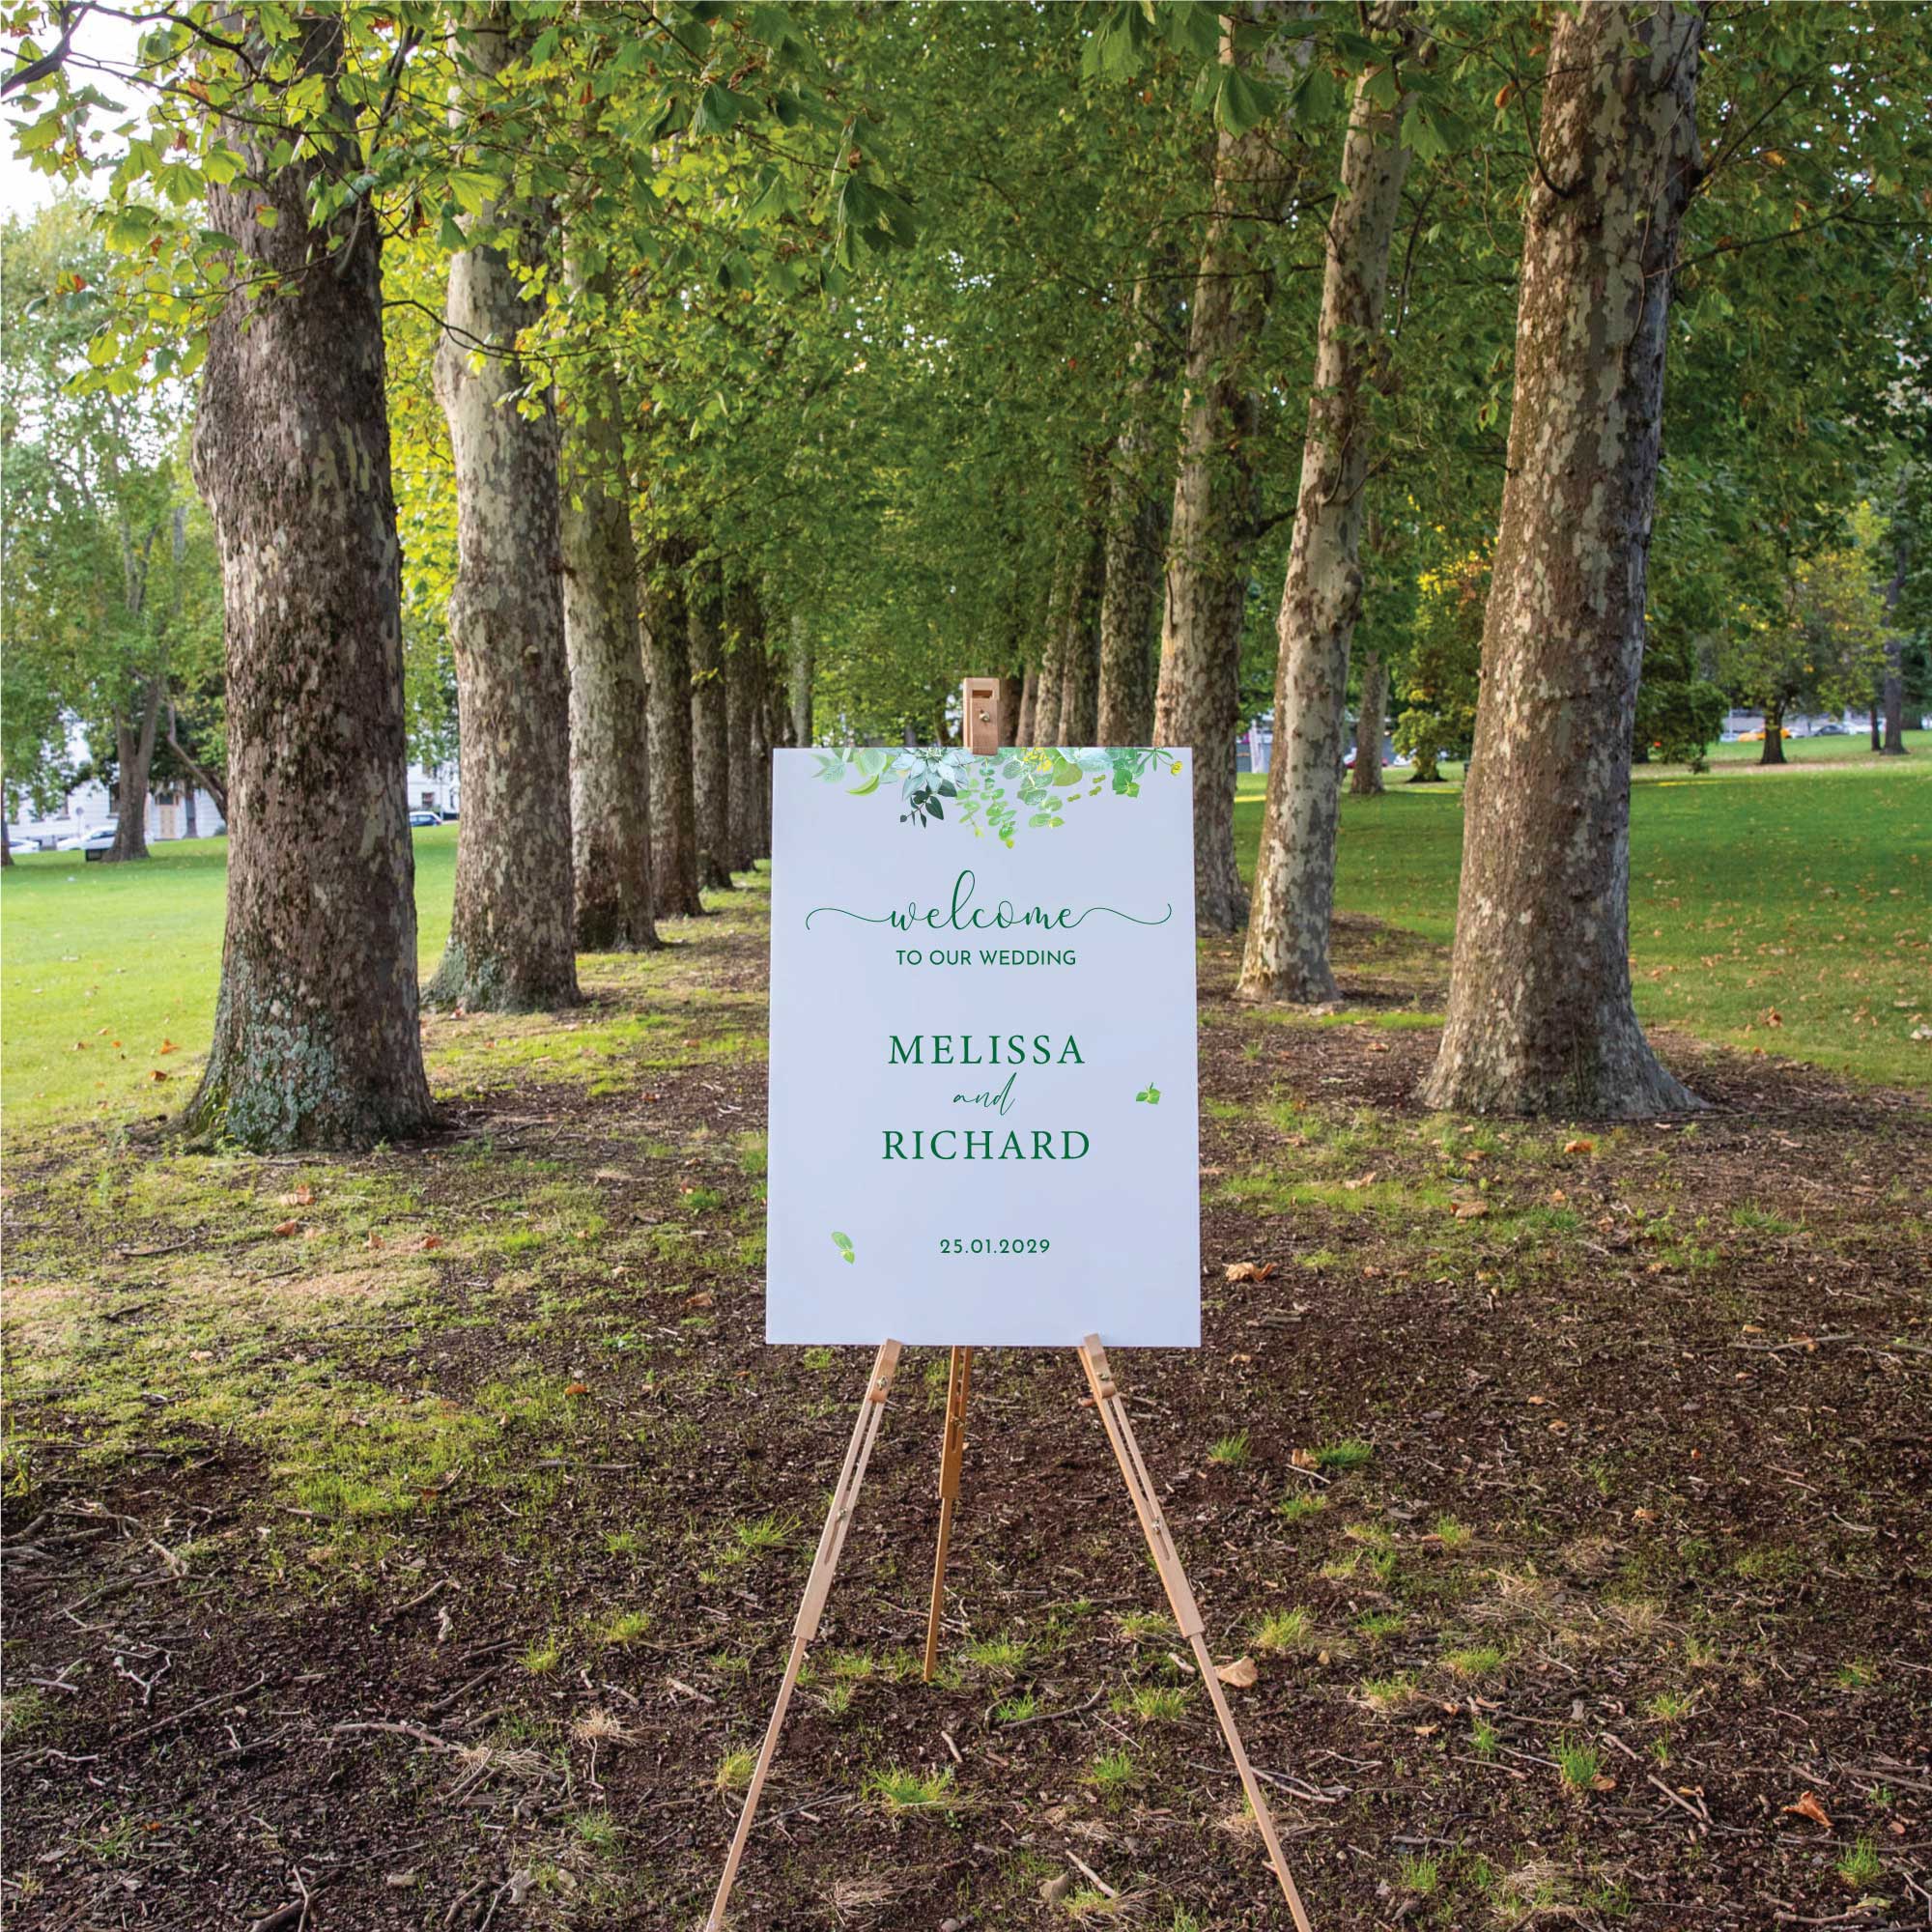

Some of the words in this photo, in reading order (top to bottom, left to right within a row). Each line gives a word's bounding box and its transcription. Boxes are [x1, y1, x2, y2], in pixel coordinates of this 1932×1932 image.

[806, 869, 1172, 931] welcome
[895, 950, 922, 965] TO
[929, 950, 972, 965] OUR
[980, 950, 1076, 965] WEDDING
[889, 1035, 1085, 1065] MELISSA
[953, 1072, 1017, 1116] and
[882, 1130, 1089, 1159] RICHARD
[940, 1238, 1050, 1254] 25.01.2029
